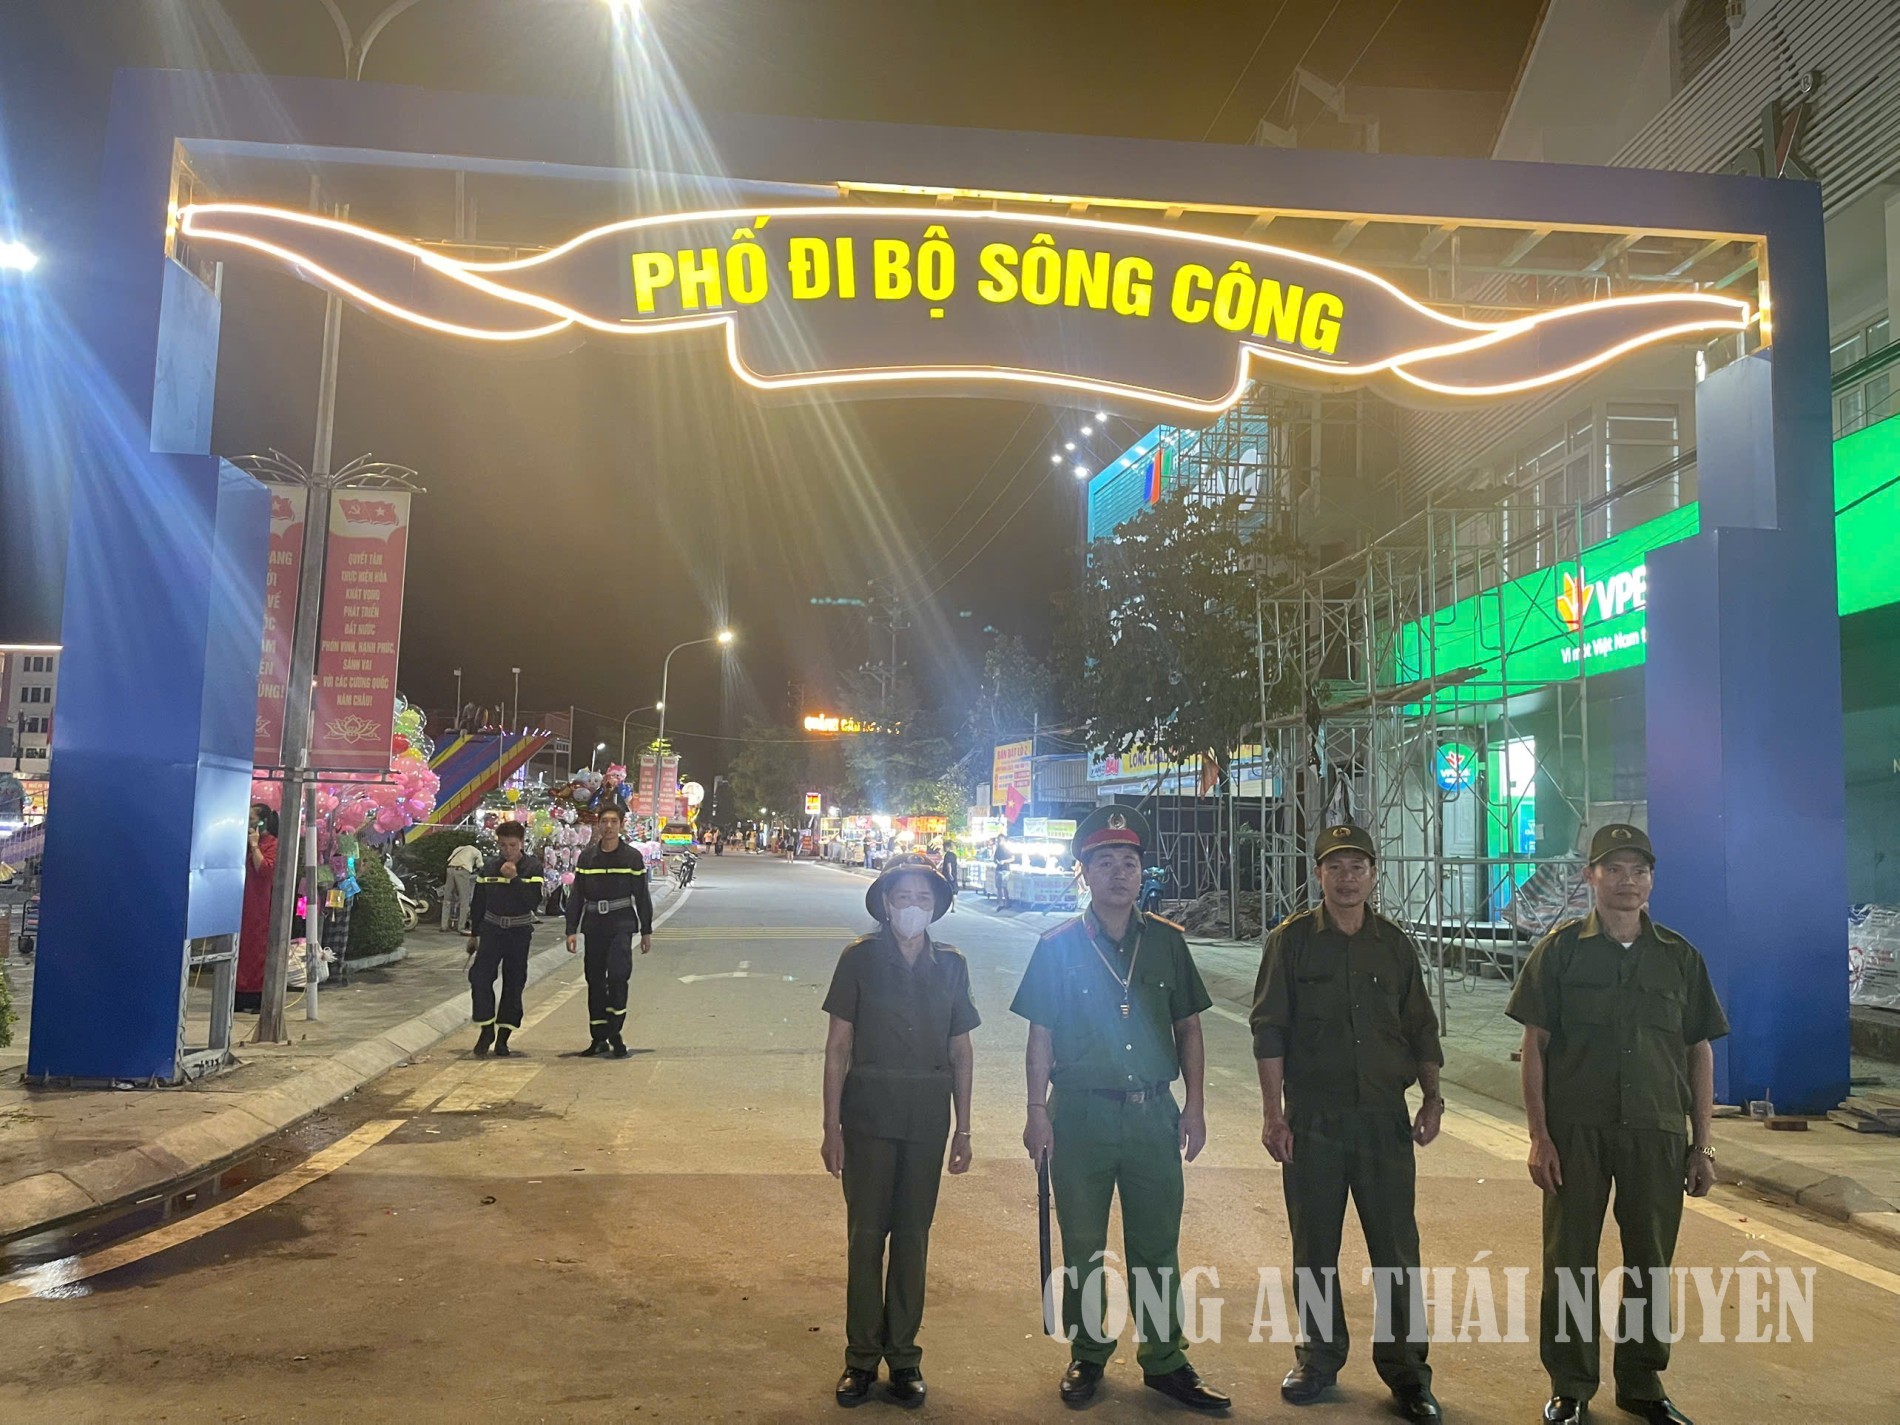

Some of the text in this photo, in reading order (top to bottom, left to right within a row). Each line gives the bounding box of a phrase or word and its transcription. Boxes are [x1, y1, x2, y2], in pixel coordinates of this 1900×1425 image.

[631, 215, 1344, 354] PHỐ ĐI BỘ SÔNG CÔNG
[1614, 631, 1640, 651] Nam
